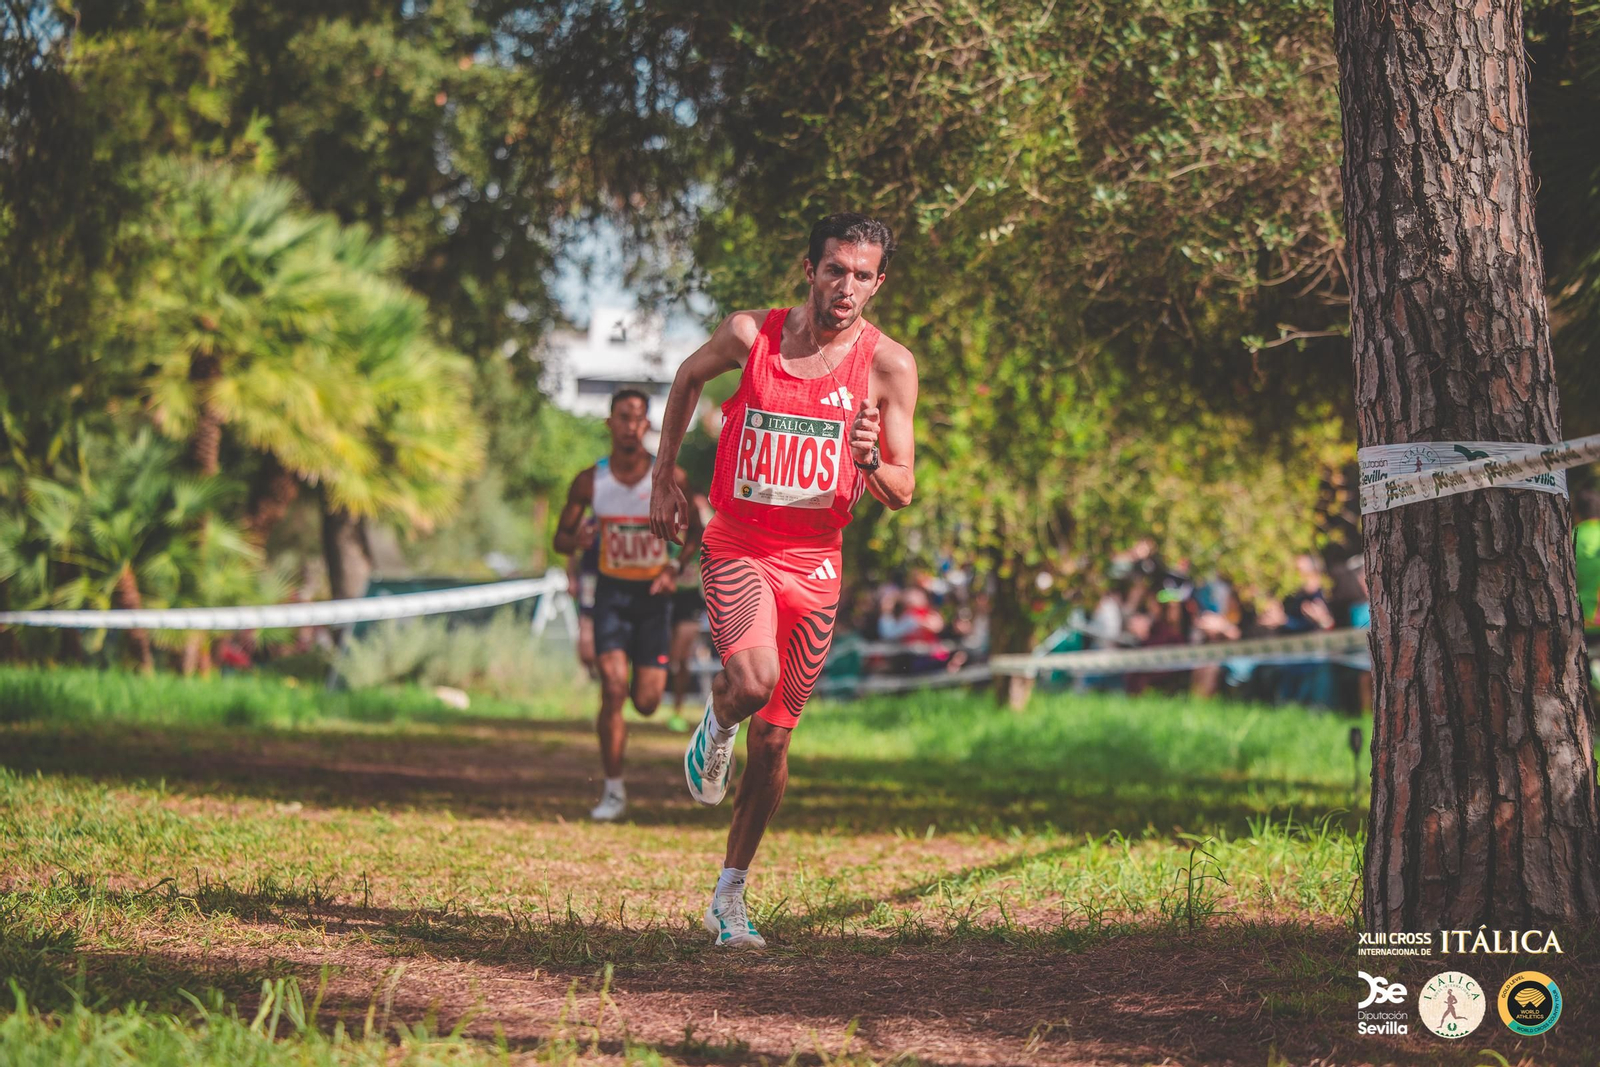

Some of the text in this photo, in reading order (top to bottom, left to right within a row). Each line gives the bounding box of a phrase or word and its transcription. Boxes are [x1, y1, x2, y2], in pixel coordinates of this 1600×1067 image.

[768, 417, 815, 433] ITÁLICA
[737, 428, 837, 491] RAMOS
[1361, 469, 1388, 486] evilla
[608, 532, 662, 560] OLIVO
